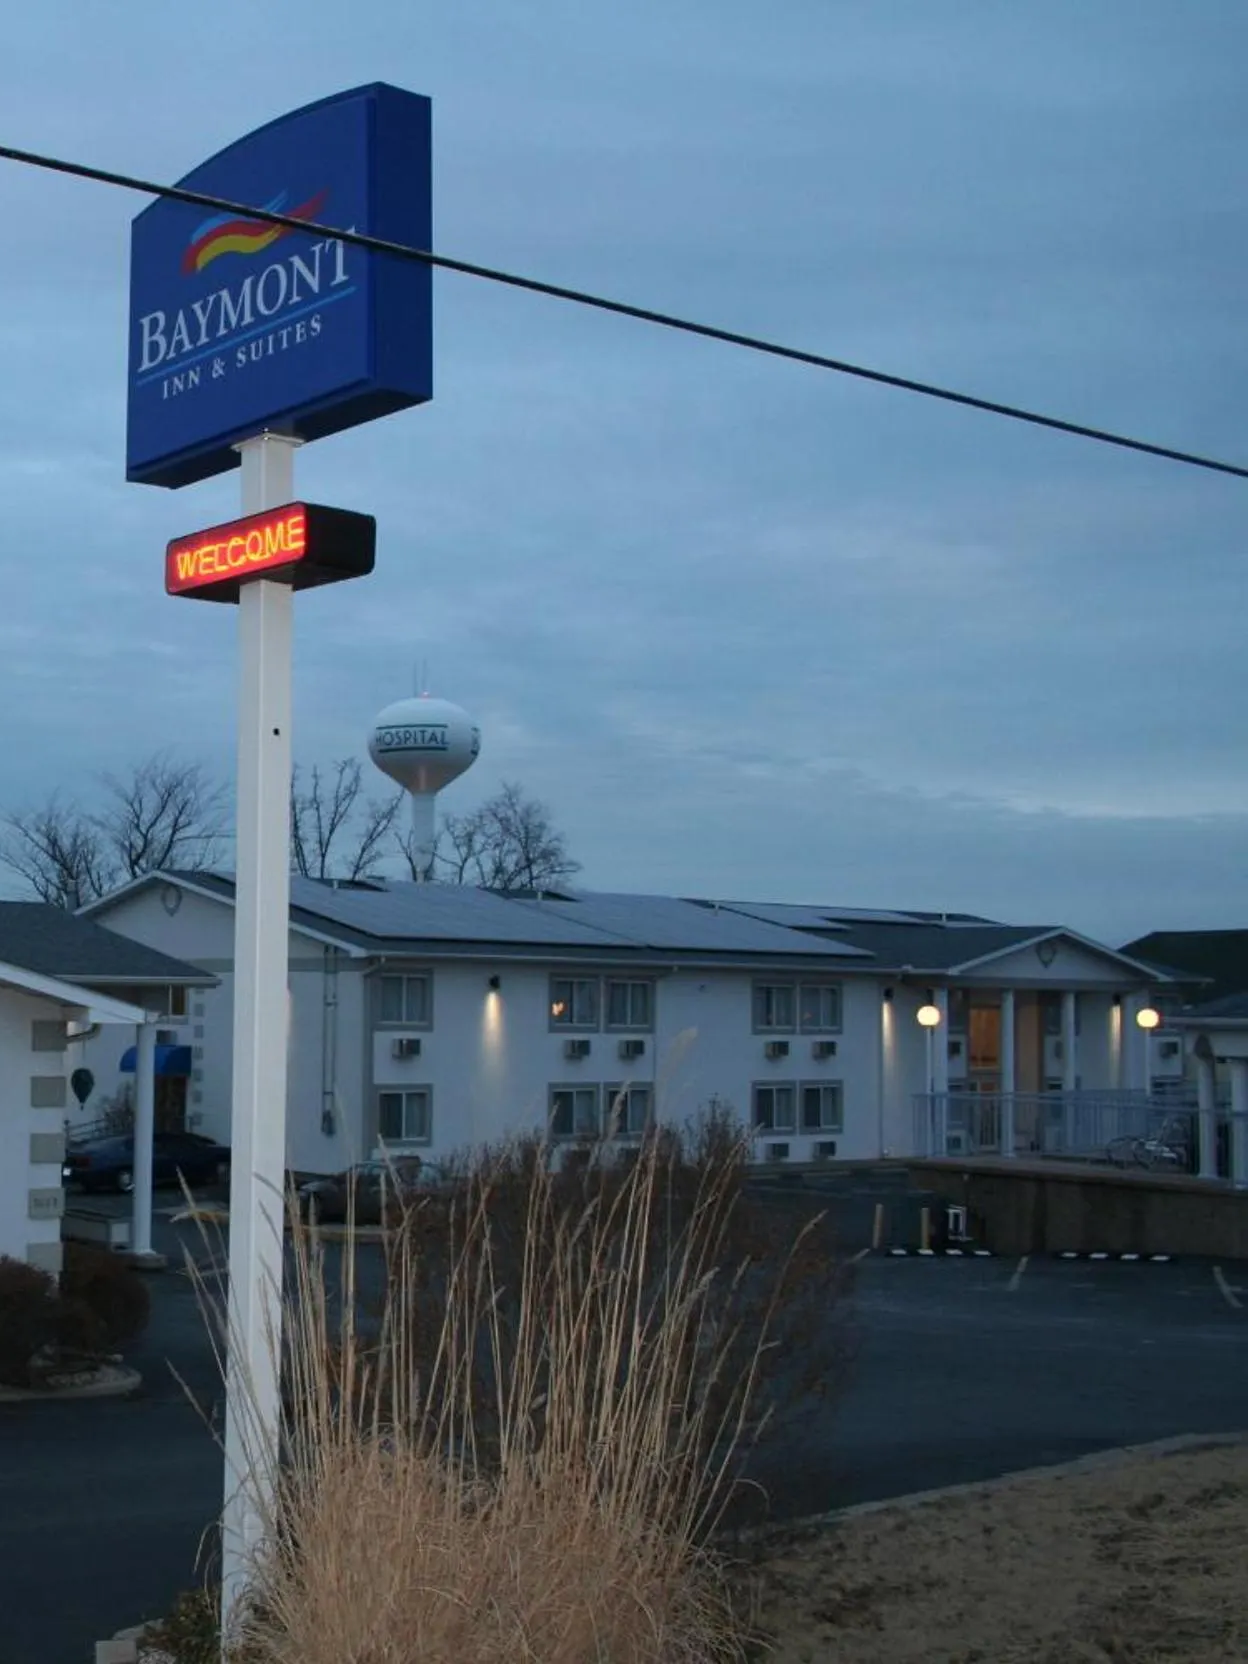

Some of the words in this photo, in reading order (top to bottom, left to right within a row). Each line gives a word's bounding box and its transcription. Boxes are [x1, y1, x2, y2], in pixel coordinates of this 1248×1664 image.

[138, 226, 357, 373] BAYMONT
[162, 367, 201, 399] INN
[211, 358, 226, 379] &
[236, 315, 322, 368] SUITES
[176, 515, 306, 580] WELCOME
[375, 729, 450, 746] HOSPITAL
